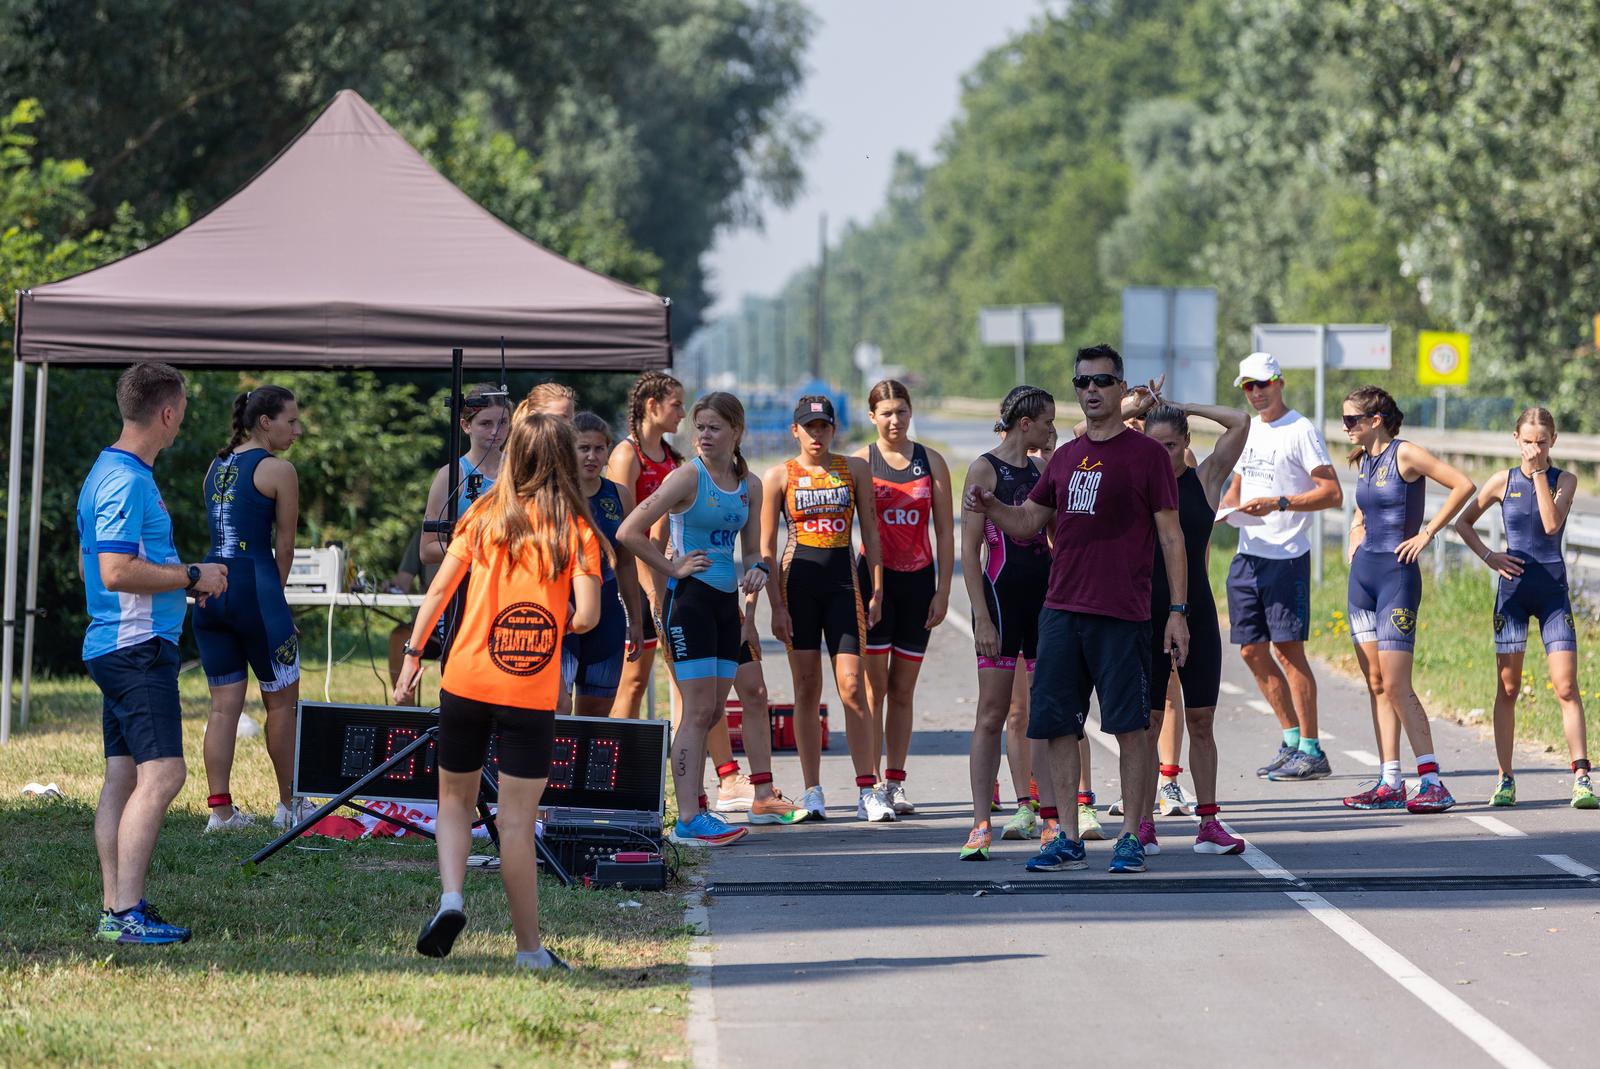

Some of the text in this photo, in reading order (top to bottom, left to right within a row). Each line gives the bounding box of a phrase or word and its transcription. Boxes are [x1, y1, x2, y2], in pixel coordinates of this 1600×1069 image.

[795, 486, 849, 511] TRIATHLON
[803, 518, 846, 532] CRO
[882, 509, 920, 525] CRO
[508, 616, 545, 624] CLUB PULA
[670, 626, 688, 659] RIVAL
